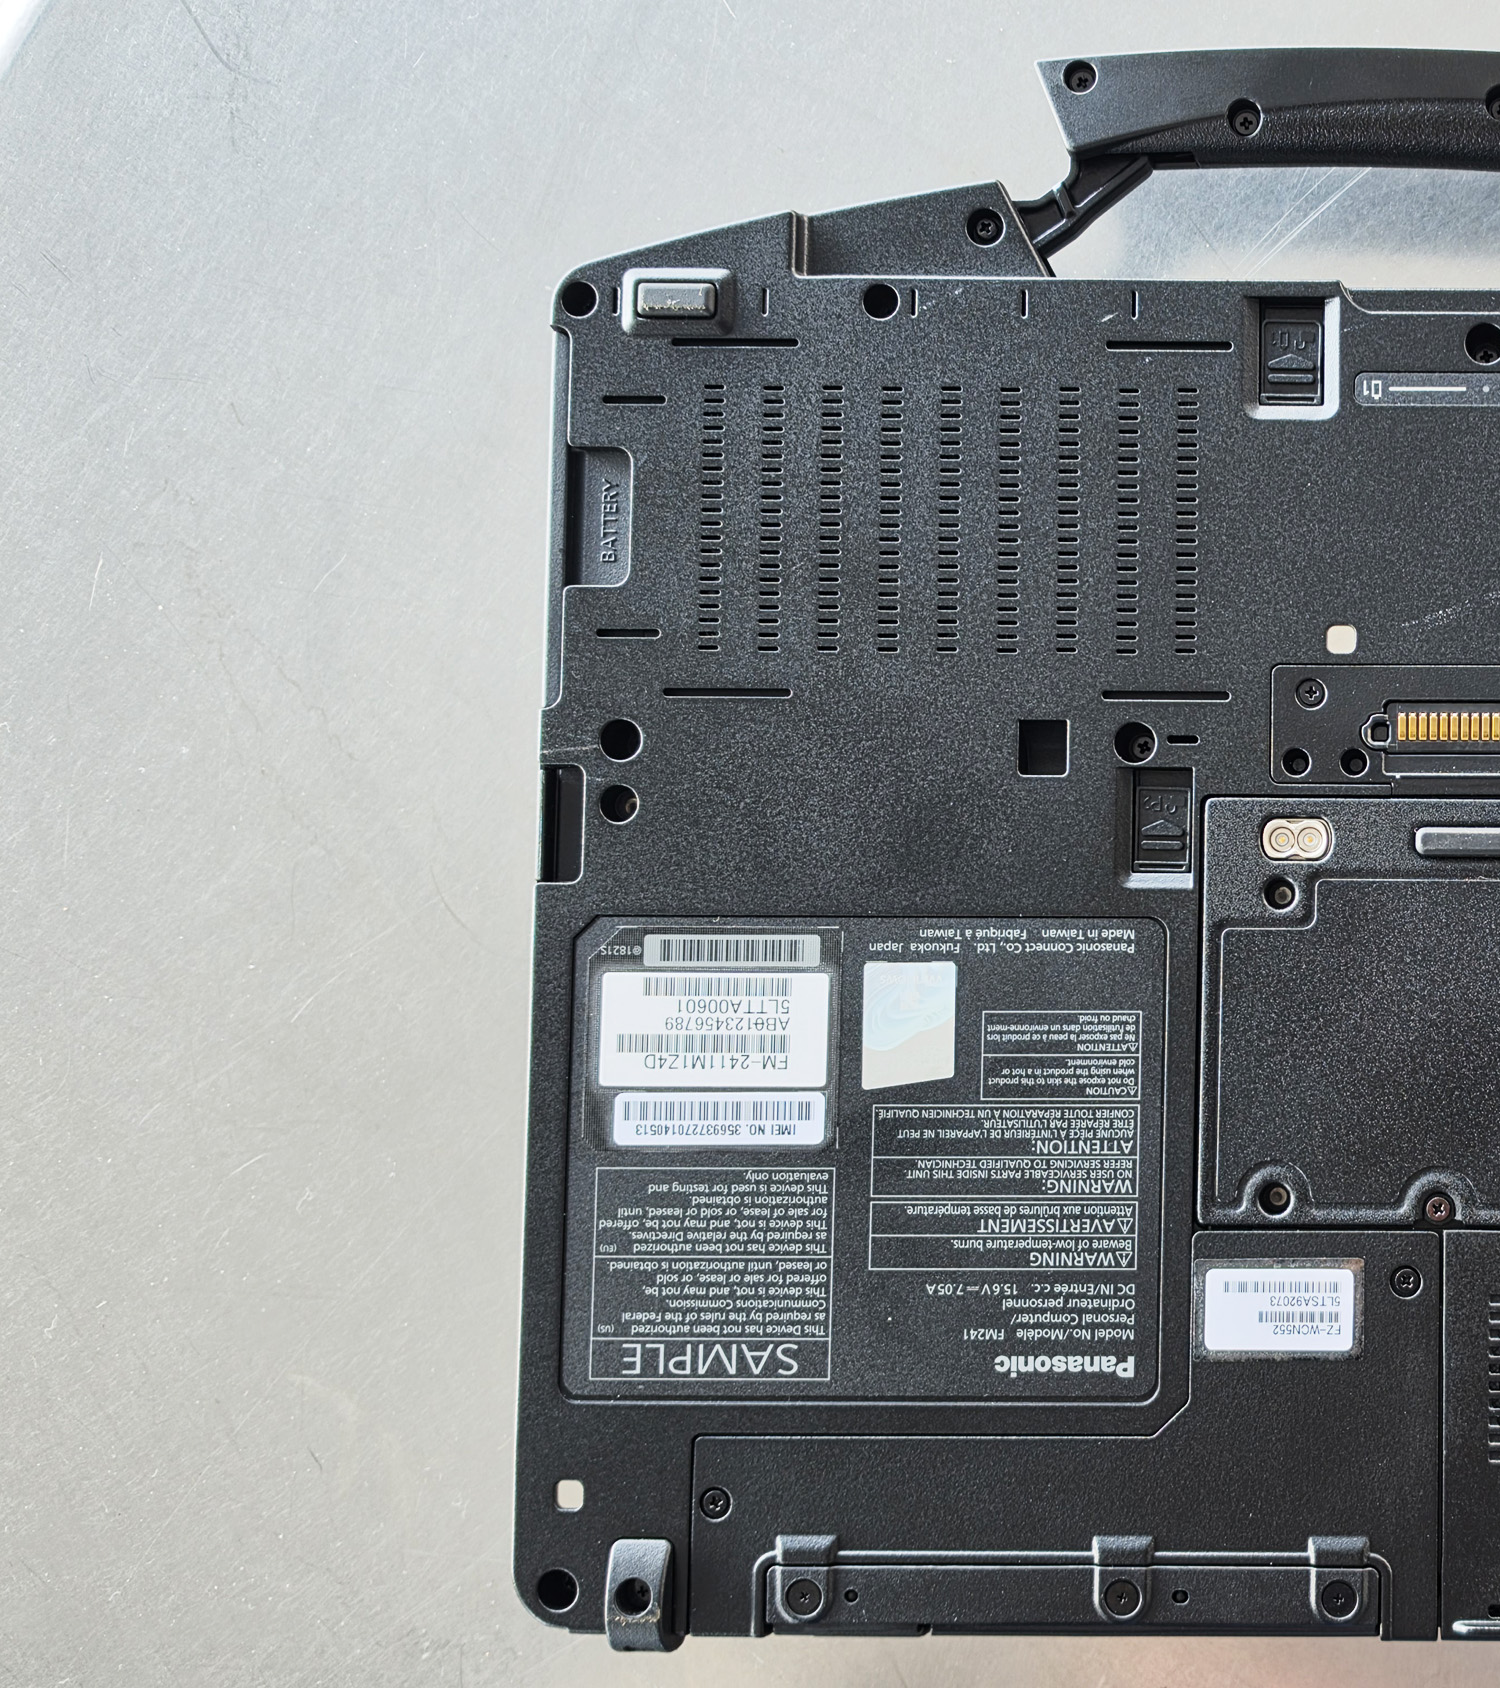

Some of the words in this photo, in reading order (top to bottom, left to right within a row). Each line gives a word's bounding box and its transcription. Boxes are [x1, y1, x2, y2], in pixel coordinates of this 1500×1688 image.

[600, 478, 619, 562] BATTERY
[920, 929, 962, 940] Taiwan
[965, 929, 972, 940] à
[975, 927, 1026, 940] Fabriqué
[1042, 929, 1085, 940] Taiwan
[1087, 929, 1098, 940] in
[1101, 929, 1135, 940] Made
[869, 940, 904, 953] Japan
[907, 943, 960, 953] Fukuoka
[974, 943, 997, 953] Ltd.
[1000, 941, 1022, 953] Co.,
[1025, 943, 1074, 953] Connect
[1076, 943, 1135, 953] Panasonic
[677, 999, 790, 1014] 5LTTA00601
[644, 1054, 788, 1069] FM-2411M1Z4D
[1012, 1068, 1025, 1076] hot
[1034, 1068, 1042, 1076] in
[1043, 1066, 1074, 1076] product
[1075, 1068, 1089, 1076] the
[1090, 1066, 1111, 1076] using
[1112, 1068, 1135, 1076] when
[988, 1075, 1019, 1086] product
[1020, 1077, 1035, 1086] this
[1036, 1077, 1045, 1086] to
[1046, 1077, 1062, 1086] skin
[1063, 1077, 1077, 1086] the
[1078, 1075, 1106, 1084] expose
[1107, 1077, 1121, 1086] not
[1122, 1077, 1134, 1086] Do
[1086, 1086, 1127, 1095] CAUTION
[876, 1109, 919, 1121] QUALIFIÉ.
[921, 1109, 975, 1118] TECHNICIEN
[977, 1109, 991, 1118] UN
[993, 1109, 1001, 1121] À
[1002, 1109, 1061, 1121] RÉPARATION
[1063, 1109, 1094, 1118] TOUTE
[1095, 1109, 1134, 1118] CONFIER
[981, 1119, 1047, 1128] L'UTILISATEUR.
[1049, 1119, 1068, 1128] PAR
[1070, 1119, 1110, 1130] RÉPARÉE
[1112, 1119, 1134, 1130] ÊTRE
[635, 1124, 741, 1135] 356937270140513
[745, 1124, 768, 1135] NO.
[771, 1124, 796, 1135] IMEI
[898, 1129, 920, 1138] PEUT
[923, 1129, 935, 1138] NE
[937, 1129, 987, 1138] L'APPAREIL
[989, 1129, 1001, 1138] DE
[1004, 1129, 1057, 1140] L'INTÉRIEUR
[1059, 1129, 1067, 1140] À
[1069, 1129, 1093, 1140] PIÈCE
[1095, 1129, 1134, 1138] AUCUNE
[1031, 1139, 1133, 1154] ATTENTION:
[915, 1159, 977, 1169] TECHNICIAN.
[979, 1159, 1031, 1169] QUALIFIED
[1033, 1159, 1047, 1169] TO
[1050, 1159, 1101, 1169] SERVICING
[1103, 1159, 1132, 1169] REFER
[904, 1169, 930, 1178] UNIT.
[932, 1169, 954, 1178] THIS
[956, 1169, 988, 1178] INSIDE
[990, 1169, 1021, 1178] PARTS
[1024, 1169, 1087, 1178] SERVICEABLE
[1089, 1169, 1114, 1178] USER
[1116, 1169, 1132, 1178] NO
[1042, 1179, 1132, 1193] WARNING:
[904, 1203, 971, 1217] température.
[973, 1205, 1001, 1217] basse
[1003, 1205, 1017, 1217] de
[1019, 1205, 1060, 1217] brûlures
[1062, 1205, 1081, 1214] aux
[1083, 1205, 1133, 1217] Attention
[977, 1218, 1115, 1233] AVERTISSEMENT
[951, 1239, 983, 1251] burns.
[985, 1236, 1075, 1251] low-temperature
[1077, 1239, 1090, 1251] of
[1092, 1239, 1132, 1251] Beware
[1029, 1251, 1115, 1266] WARNING
[606, 1261, 659, 1271] obtained.
[661, 1261, 669, 1271] is
[671, 1261, 745, 1271] authorization
[748, 1261, 772, 1271] until
[775, 1260, 812, 1271] leased,
[814, 1261, 827, 1269] or
[657, 1274, 679, 1284] sold
[680, 1274, 693, 1282] or
[696, 1273, 726, 1284] lease,
[728, 1274, 741, 1282] or
[743, 1274, 764, 1284] sale
[766, 1274, 783, 1284] for
[786, 1274, 827, 1284] offered
[642, 1286, 659, 1297] be,
[661, 1287, 680, 1297] not
[682, 1285, 706, 1294] may
[709, 1287, 730, 1297] and
[733, 1286, 755, 1297] not,
[757, 1287, 765, 1297] is
[768, 1287, 803, 1297] device
[805, 1287, 827, 1297] This
[1031, 1283, 1051, 1292] c.c.
[1053, 1282, 1114, 1295] IN/Entrée
[1117, 1283, 1135, 1295] DC
[666, 1299, 733, 1309] Commission.
[736, 1299, 826, 1309] Communications
[1002, 1296, 1063, 1310] personnel
[1066, 1298, 1135, 1310] Ordinateur
[1270, 1296, 1341, 1307] 5LTSA92073
[622, 1312, 662, 1322] Federal
[664, 1312, 683, 1322] the
[685, 1312, 697, 1322] of
[700, 1312, 725, 1322] rules
[728, 1312, 747, 1322] the
[749, 1310, 762, 1322] by
[765, 1310, 811, 1322] required
[814, 1312, 826, 1320] as
[1010, 1311, 1079, 1325] Computer/
[1082, 1313, 1135, 1325] Personal
[631, 1325, 690, 1335] authorized
[693, 1325, 720, 1335] been
[722, 1325, 742, 1335] not
[744, 1325, 763, 1335] has
[766, 1325, 801, 1335] Device
[804, 1325, 826, 1335] This
[963, 1328, 1004, 1339] FM241
[1016, 1328, 1091, 1340] No./Modèle
[1094, 1329, 1135, 1340] Model
[1272, 1325, 1341, 1335] FZ-WCN552
[621, 1343, 799, 1375] SAMPLE
[994, 1355, 1135, 1378] Panasonic
